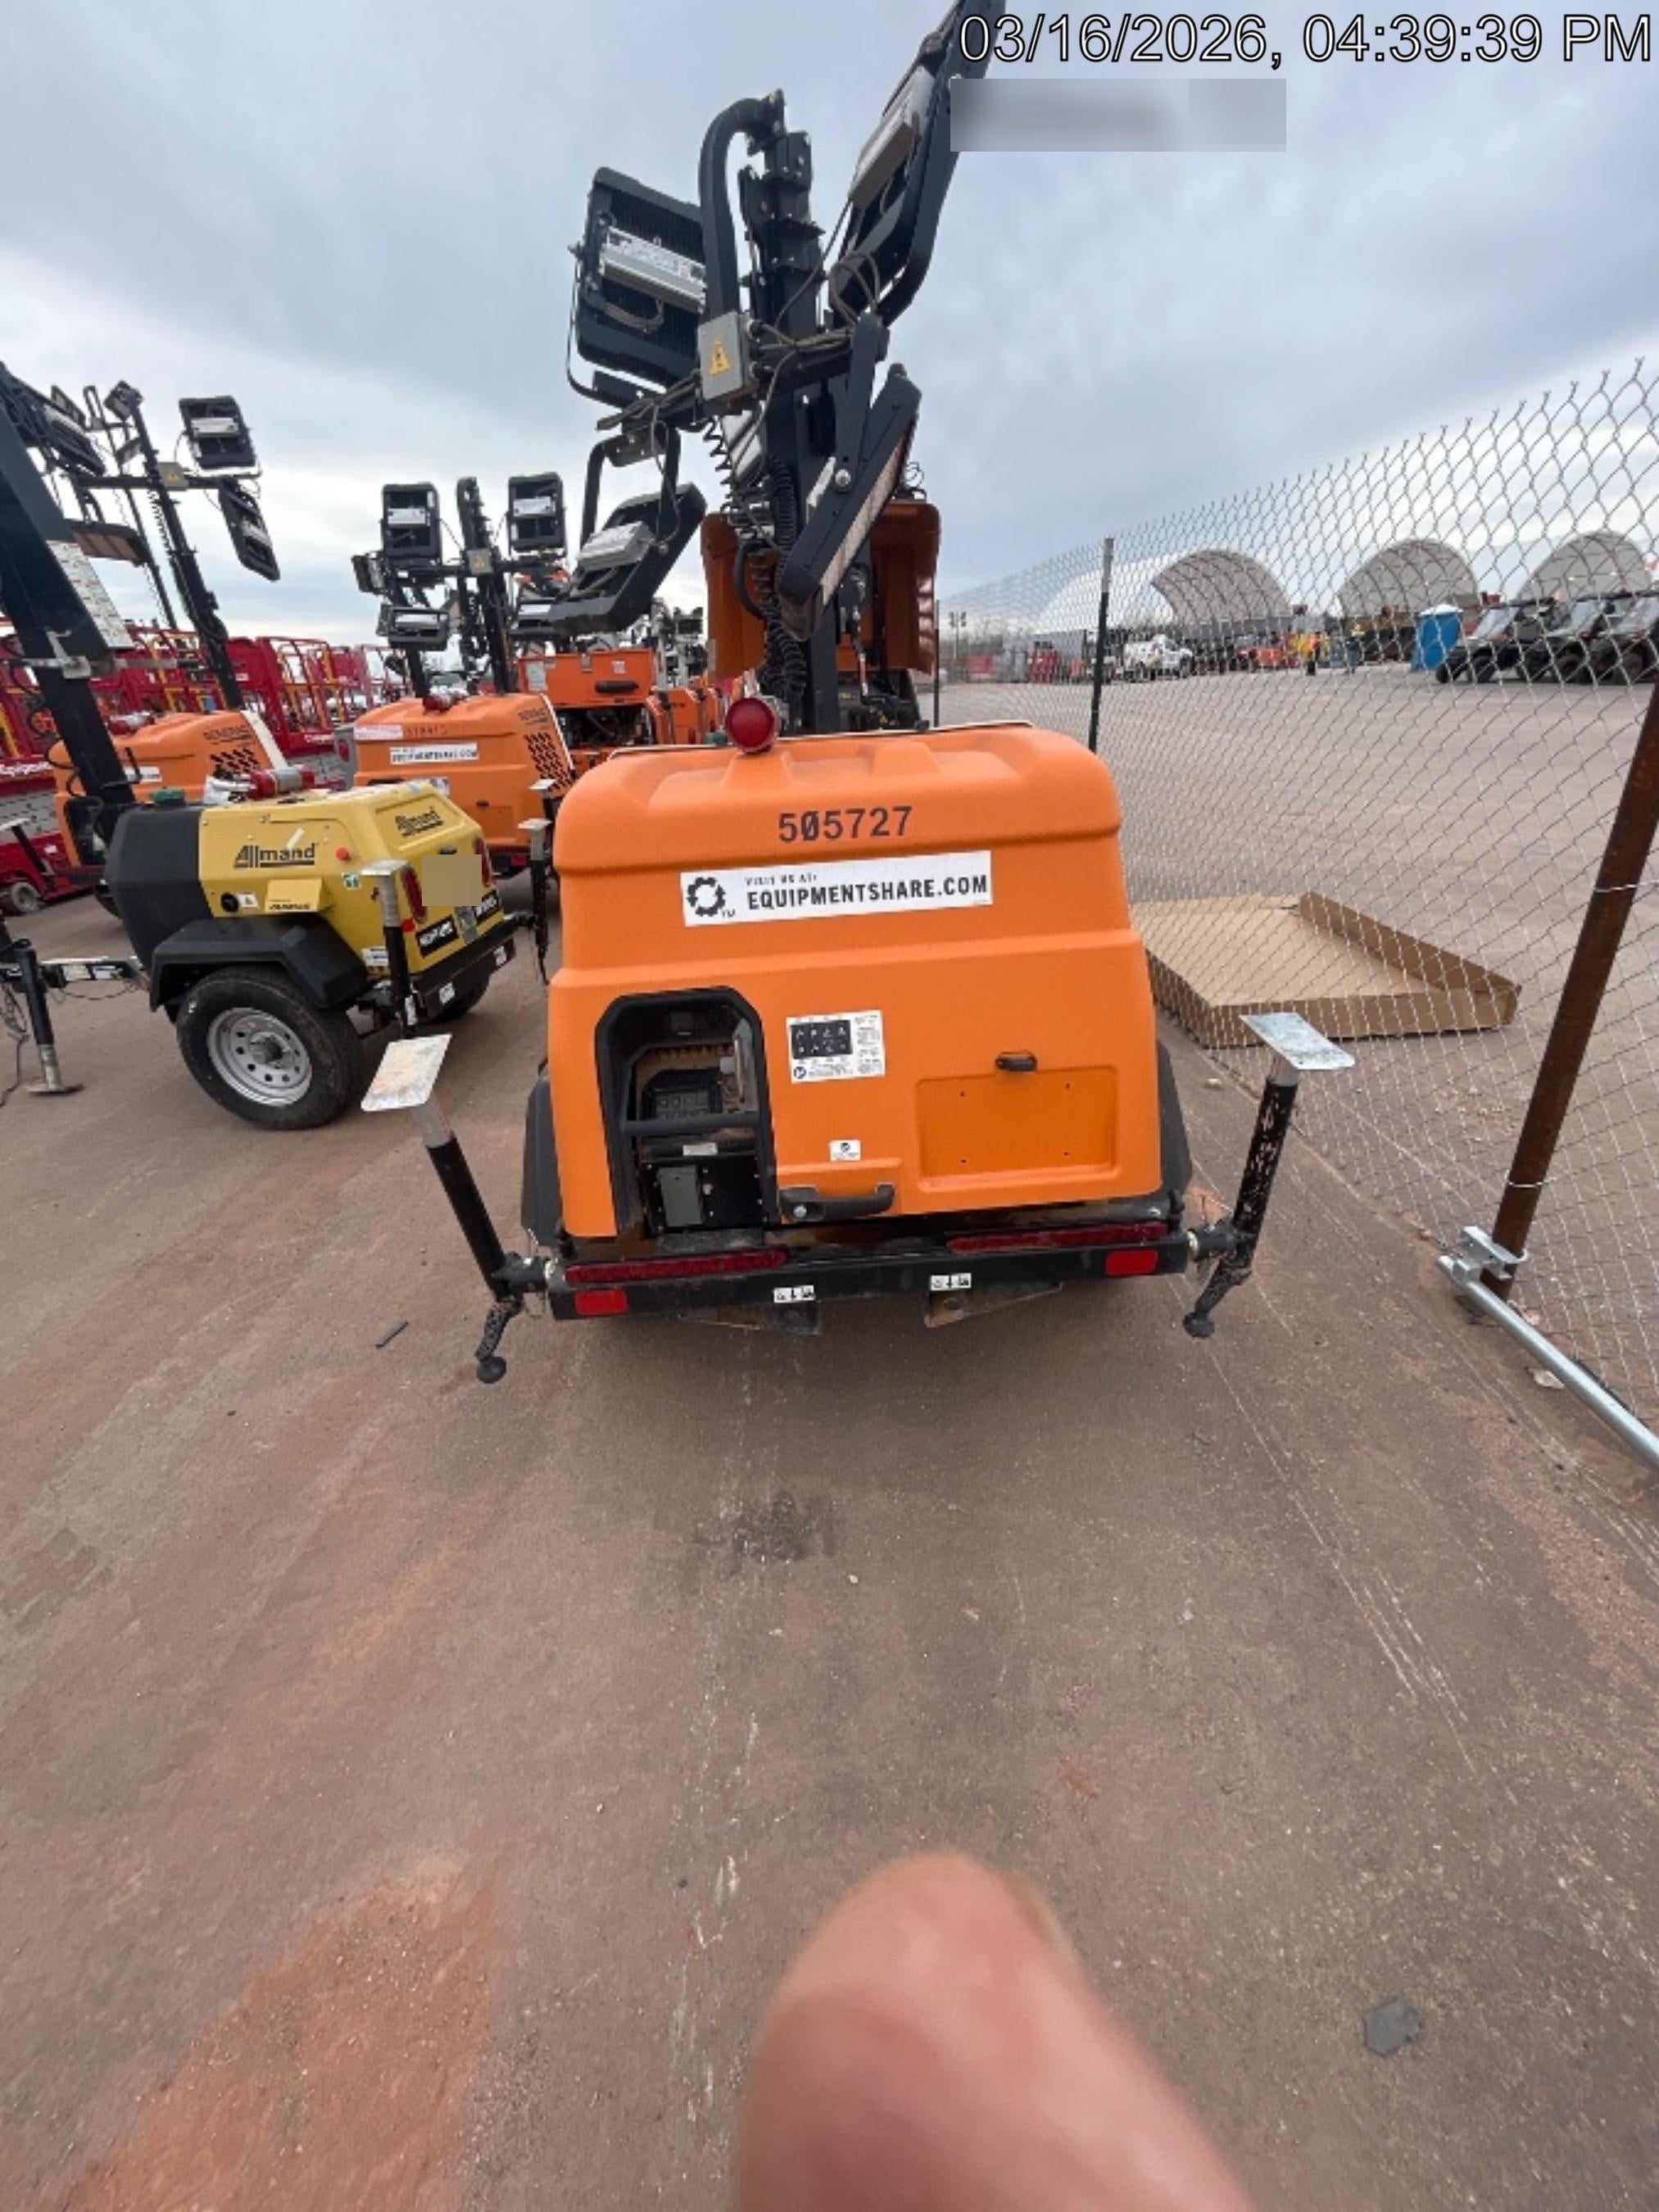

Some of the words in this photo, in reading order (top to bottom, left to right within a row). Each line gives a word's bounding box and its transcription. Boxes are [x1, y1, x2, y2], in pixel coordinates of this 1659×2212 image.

[778, 805, 913, 842] 505727
[233, 843, 316, 868] Allmand
[746, 874, 987, 910] EQUIPMENTSHARE.COM
